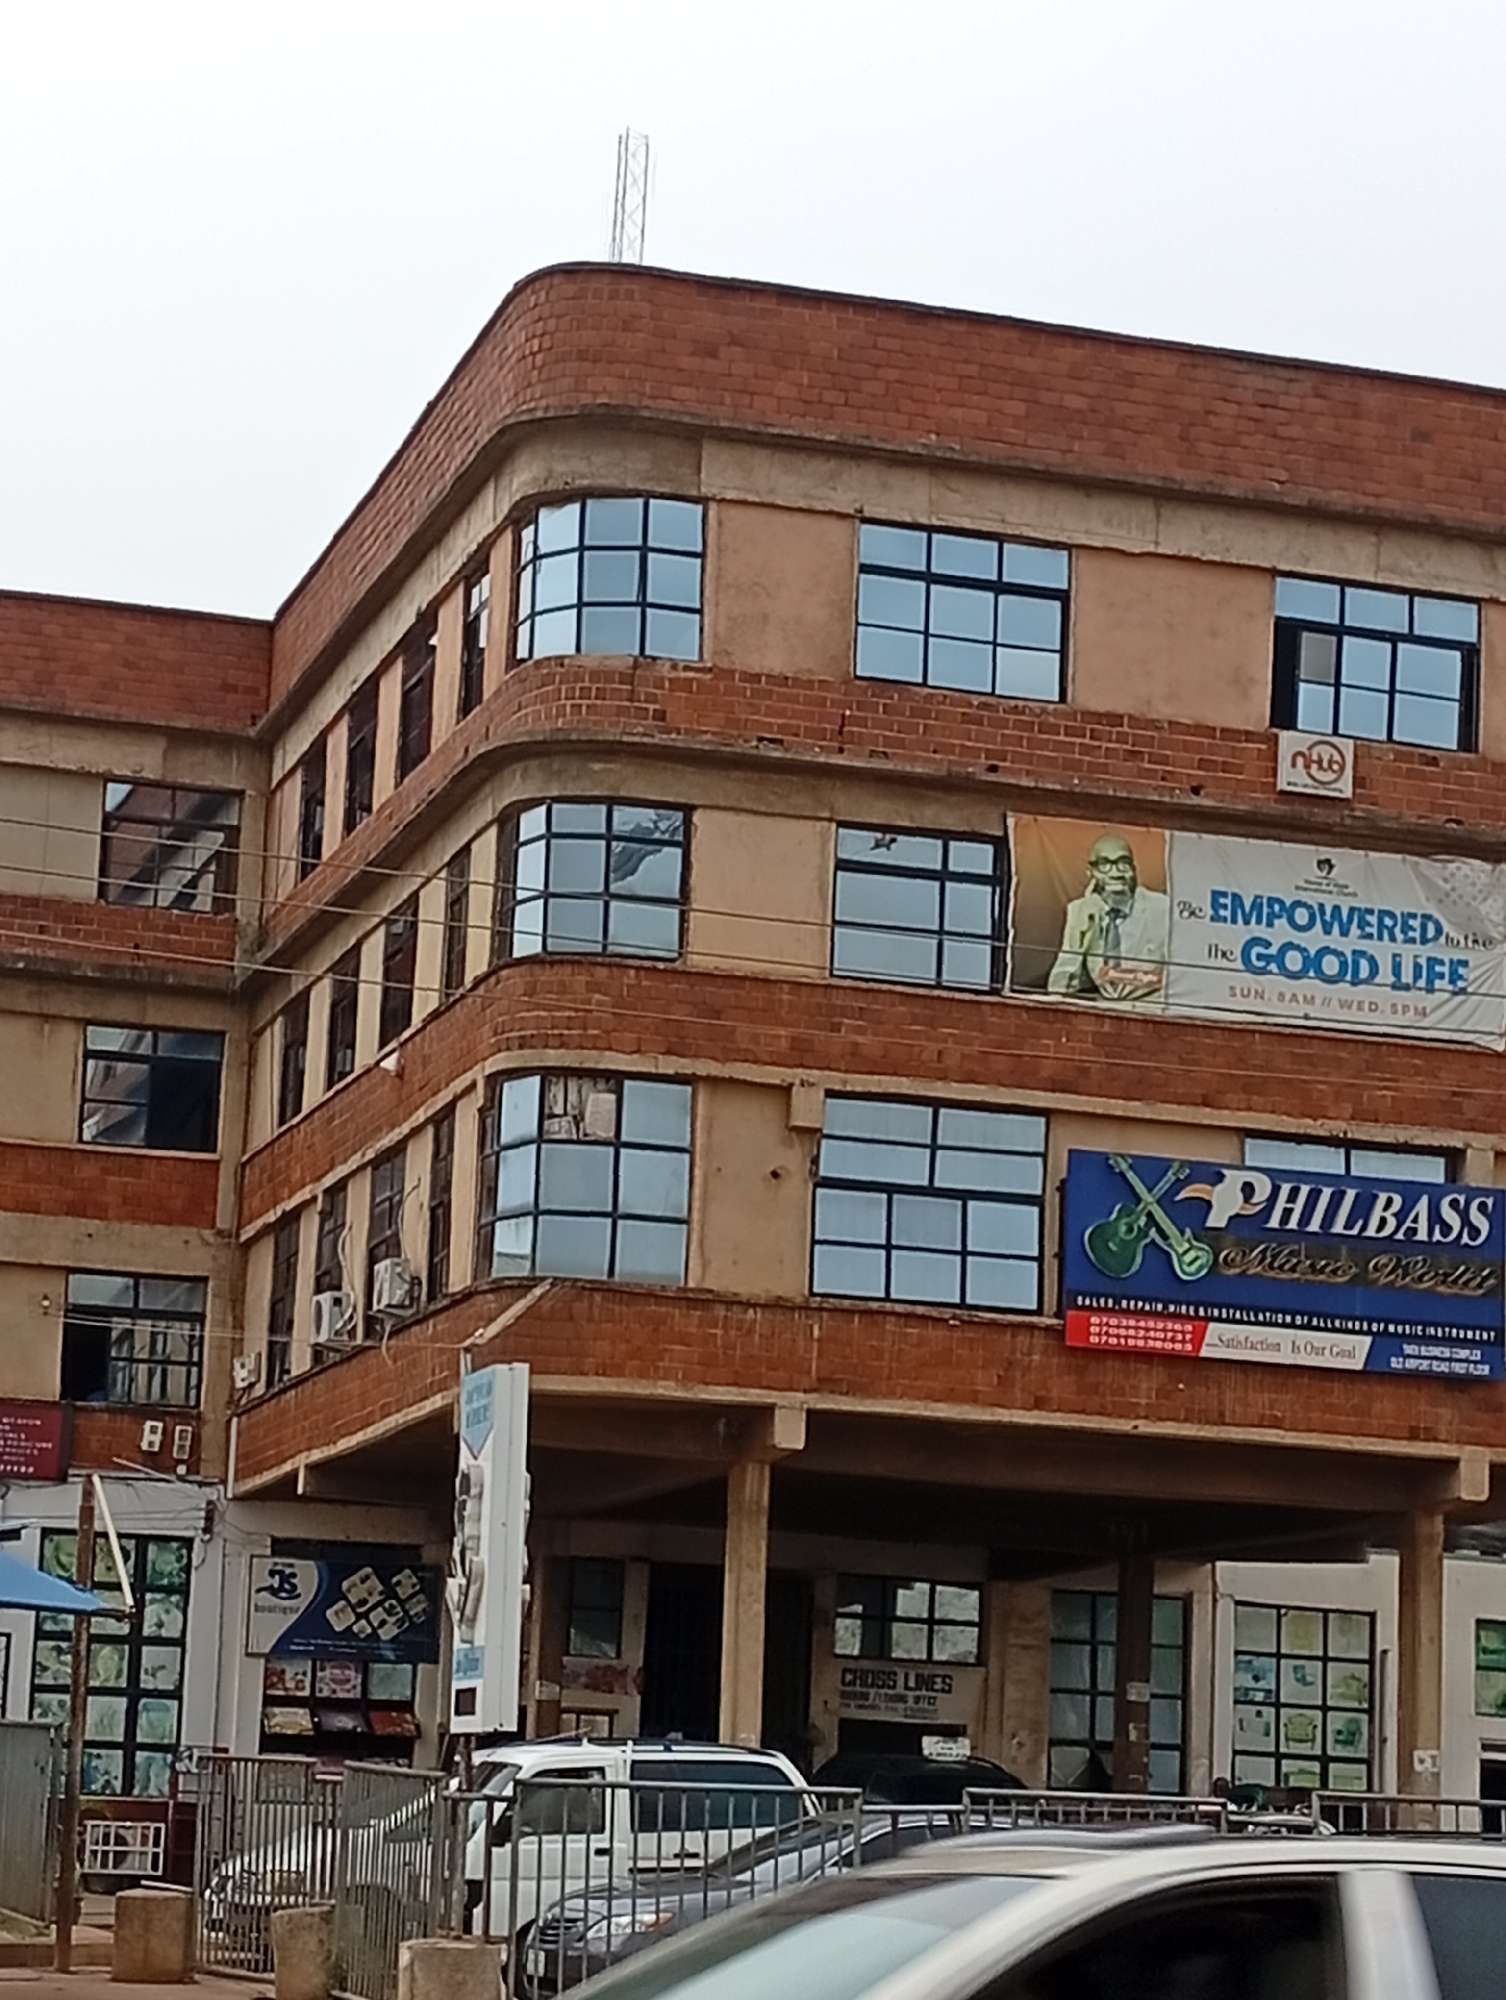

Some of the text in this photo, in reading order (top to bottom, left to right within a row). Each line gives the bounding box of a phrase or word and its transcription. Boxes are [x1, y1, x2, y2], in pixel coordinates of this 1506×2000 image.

[1177, 900, 1206, 920] Be
[1209, 889, 1444, 947] EMPOWERED
[1240, 936, 1379, 986] GOOD
[1391, 953, 1469, 996] LIFE
[1204, 1168, 1495, 1247] PHILBASS
[1218, 1243, 1359, 1283] Music
[1217, 1332, 1356, 1360] Satisfaction Is Our Goal
[1371, 1322, 1385, 1333] OF
[1388, 1323, 1423, 1336] MUSIC
[841, 1667, 954, 1694] CROSS LINES
